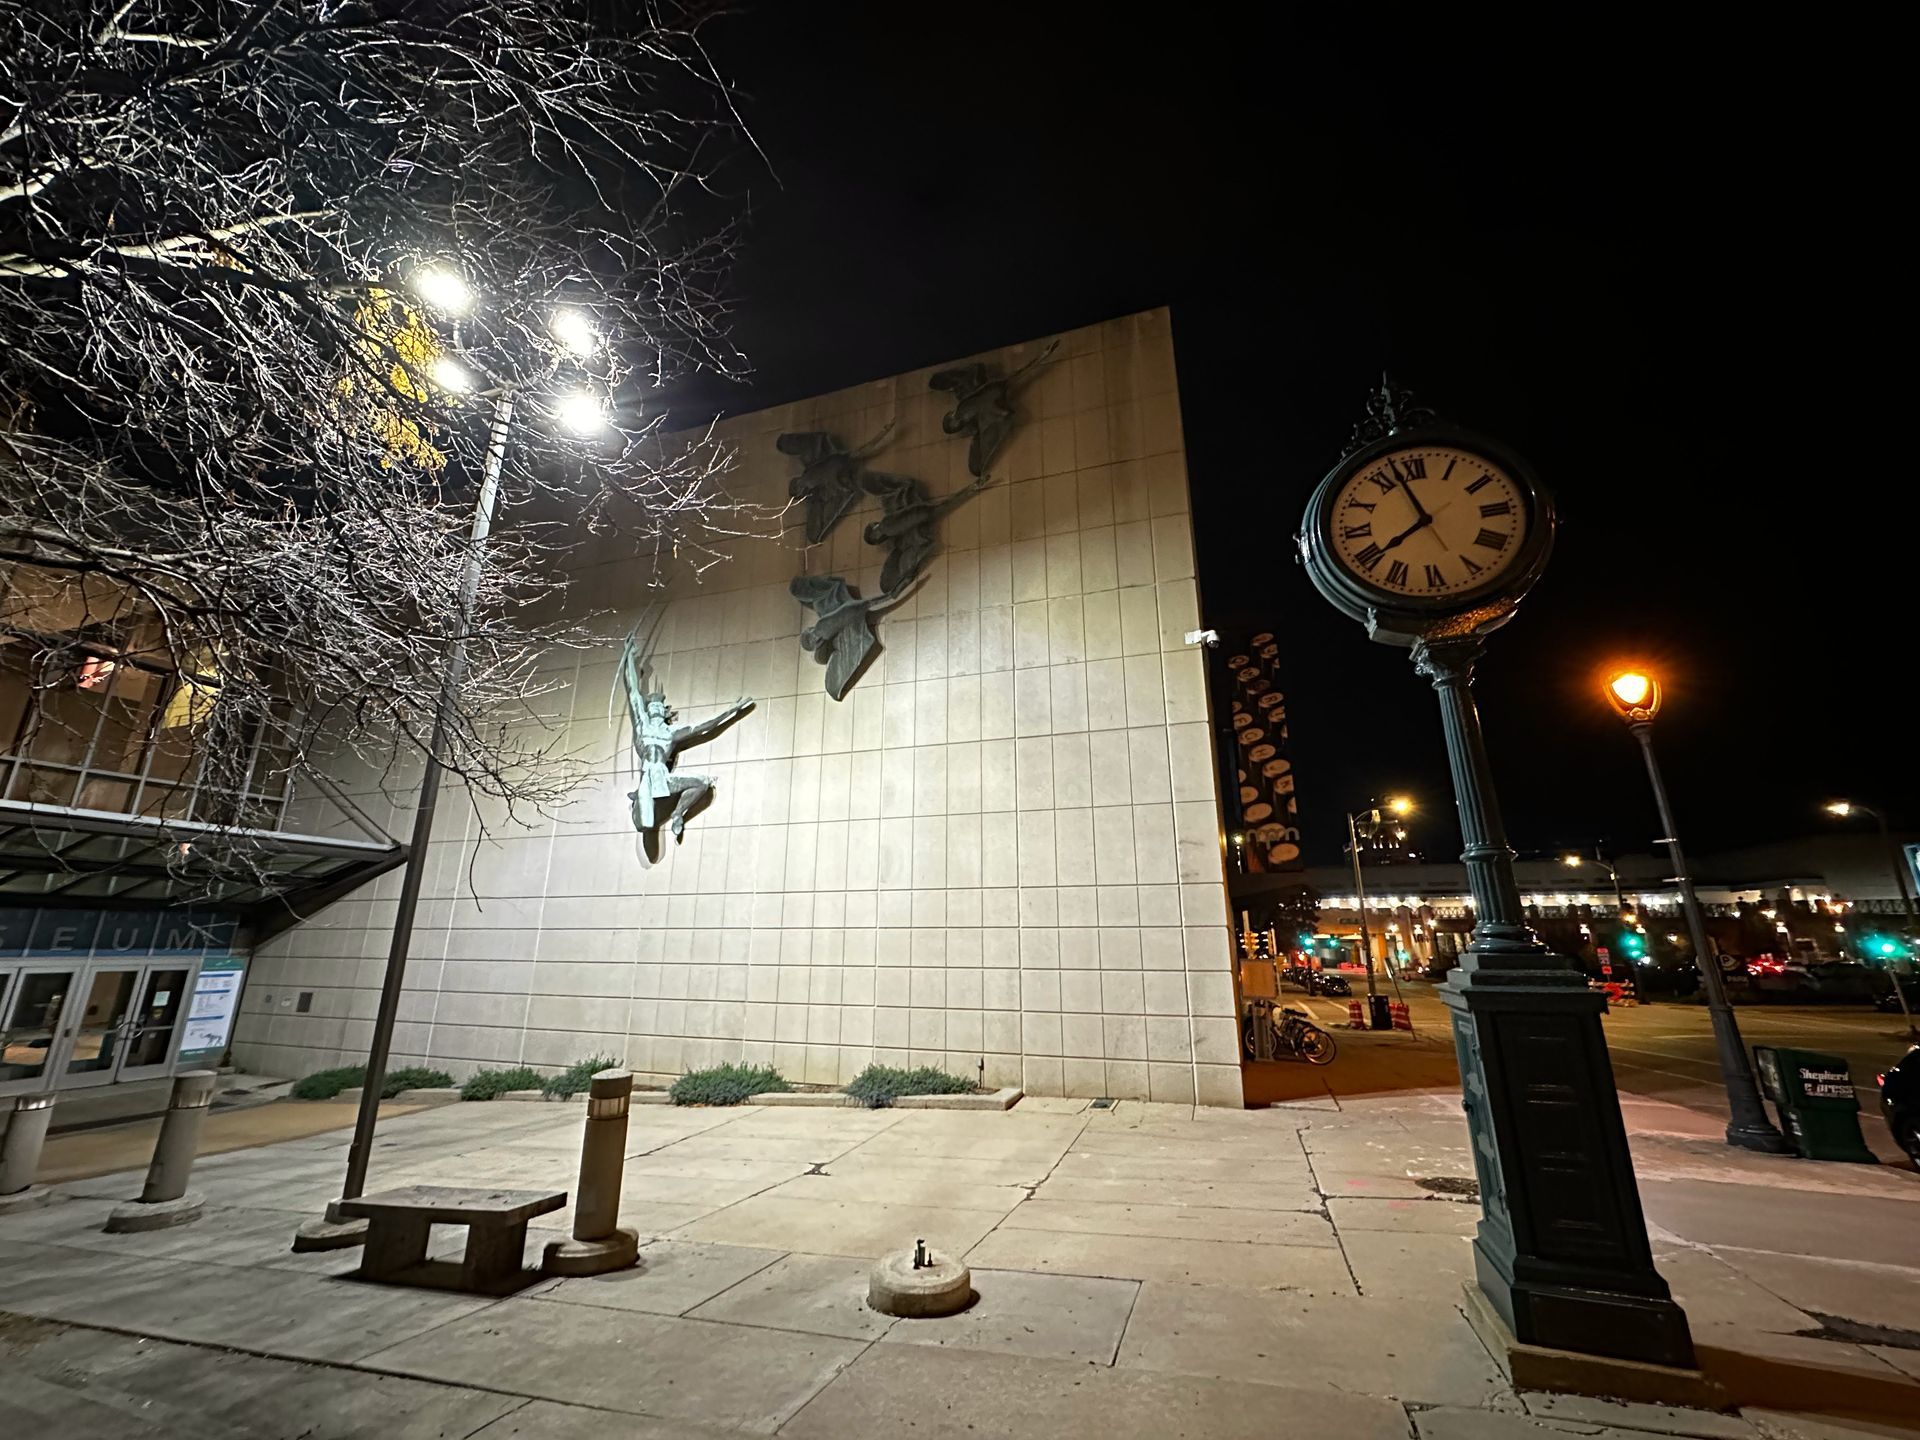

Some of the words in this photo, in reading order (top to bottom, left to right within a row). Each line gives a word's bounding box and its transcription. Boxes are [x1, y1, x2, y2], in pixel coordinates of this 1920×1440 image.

[1401, 459, 1426, 481] XII
[1370, 471, 1396, 495] XI
[1464, 474, 1492, 495] II
[1349, 501, 1376, 514] X
[1480, 501, 1511, 518] III
[1345, 523, 1371, 539] IX
[1474, 528, 1509, 551] IIII
[1354, 543, 1385, 572] VIII
[1459, 555, 1483, 575] V
[1385, 560, 1409, 587] VII
[1425, 564, 1447, 588] VI
[1799, 1067, 1849, 1083] Shepherd
